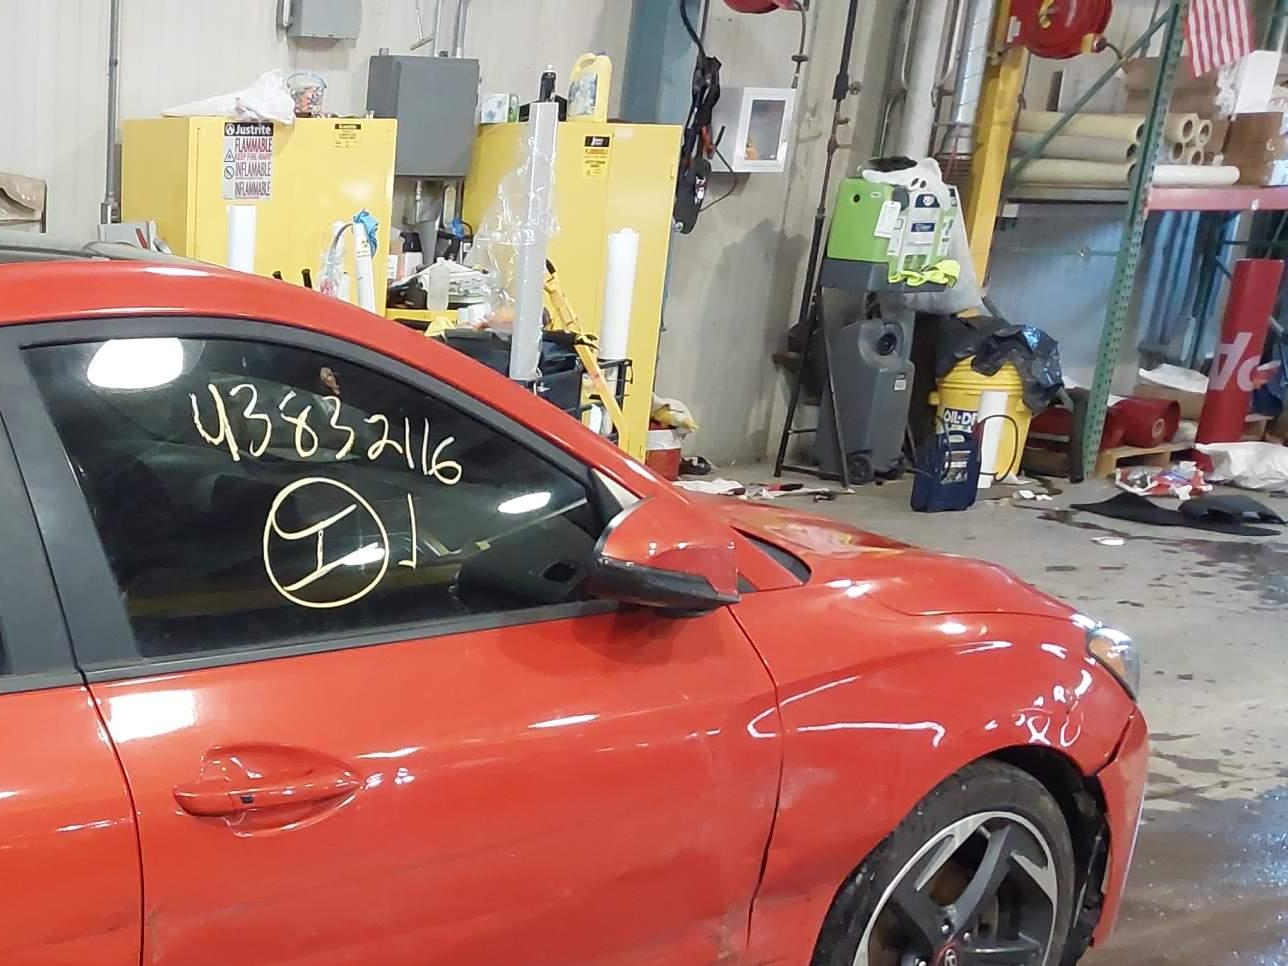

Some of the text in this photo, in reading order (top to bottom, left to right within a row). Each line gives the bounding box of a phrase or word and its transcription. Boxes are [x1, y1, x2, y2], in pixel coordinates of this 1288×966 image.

[235, 124, 271, 135] Justrite
[235, 138, 272, 152] FLAMMABLE
[190, 384, 462, 485] 43832116
